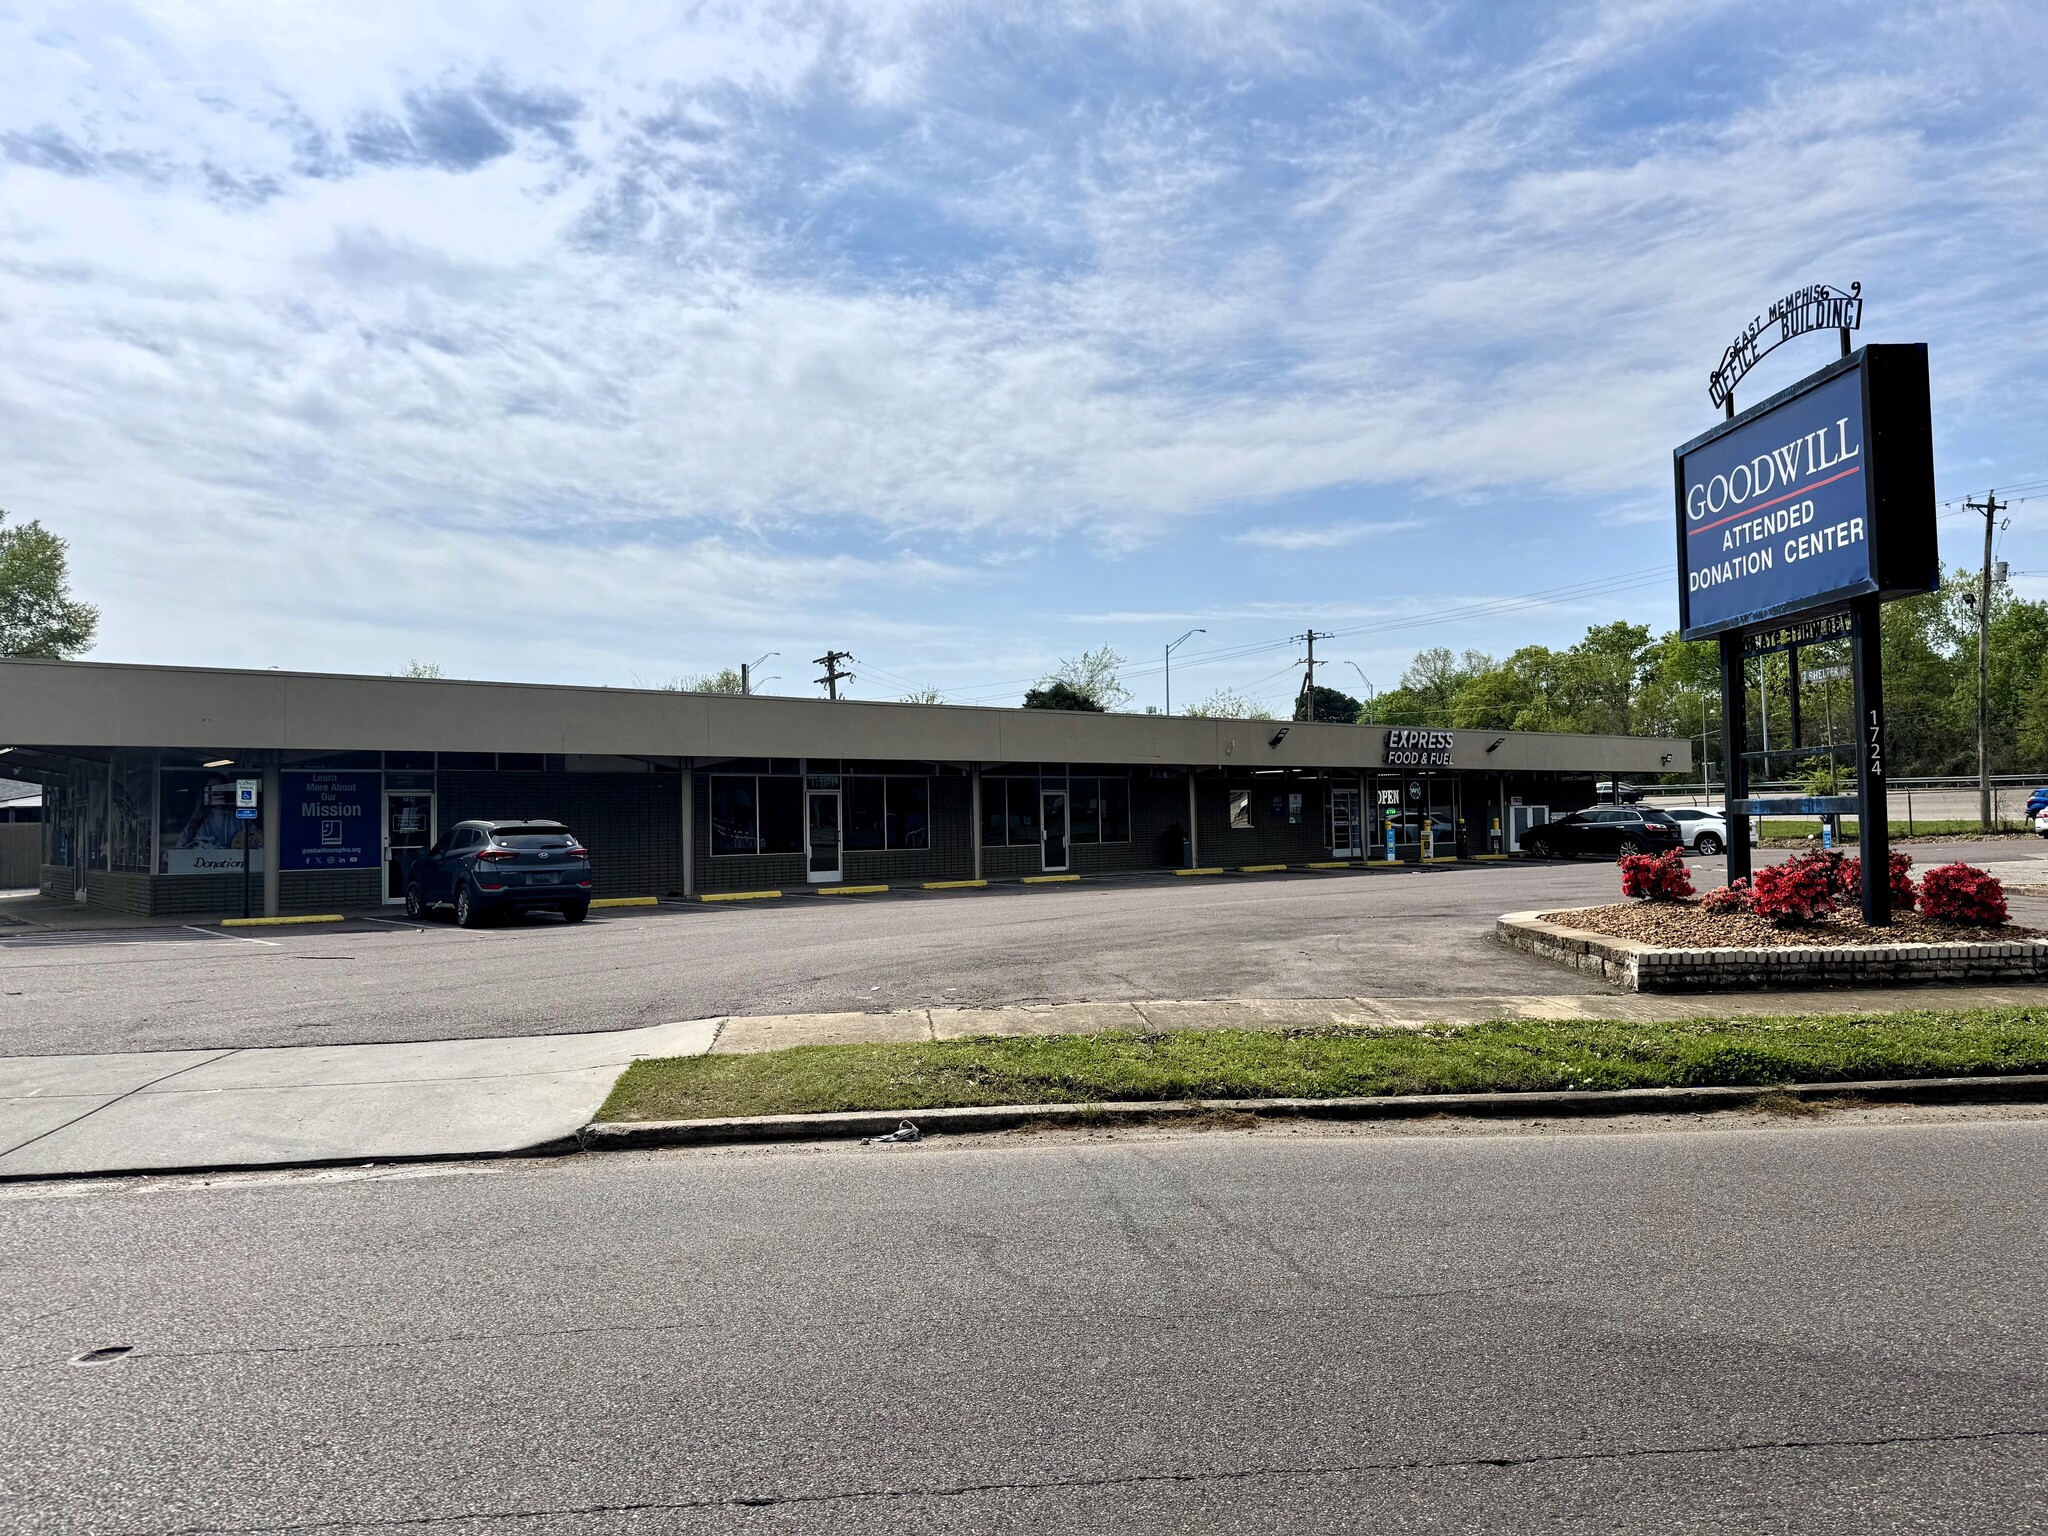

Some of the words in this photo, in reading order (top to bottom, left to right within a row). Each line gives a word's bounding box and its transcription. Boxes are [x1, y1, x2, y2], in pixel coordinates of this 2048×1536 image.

[1733, 315, 1761, 351] EAST
[1768, 284, 1821, 321] MEMPHIS
[1713, 339, 1760, 400] OFFICE
[1780, 300, 1854, 341] BUILDING
[1687, 417, 1859, 520] GOODWILL
[1722, 500, 1814, 551] ATTENDED
[1689, 547, 1773, 592] DONATION
[1784, 517, 1864, 563] CENTER
[1808, 667, 1839, 680] SHELTER
[1389, 730, 1454, 749] EXPRESS
[1869, 710, 1882, 775] 1724
[1388, 752, 1419, 765] FOOD
[1420, 752, 1427, 764] &
[1430, 752, 1454, 765] FUEL
[313, 773, 337, 782] Learn
[306, 783, 329, 791] More
[331, 783, 357, 791] About
[321, 792, 337, 800] Our
[301, 802, 362, 817] Mission
[302, 847, 362, 855] goodwillmemphis.org
